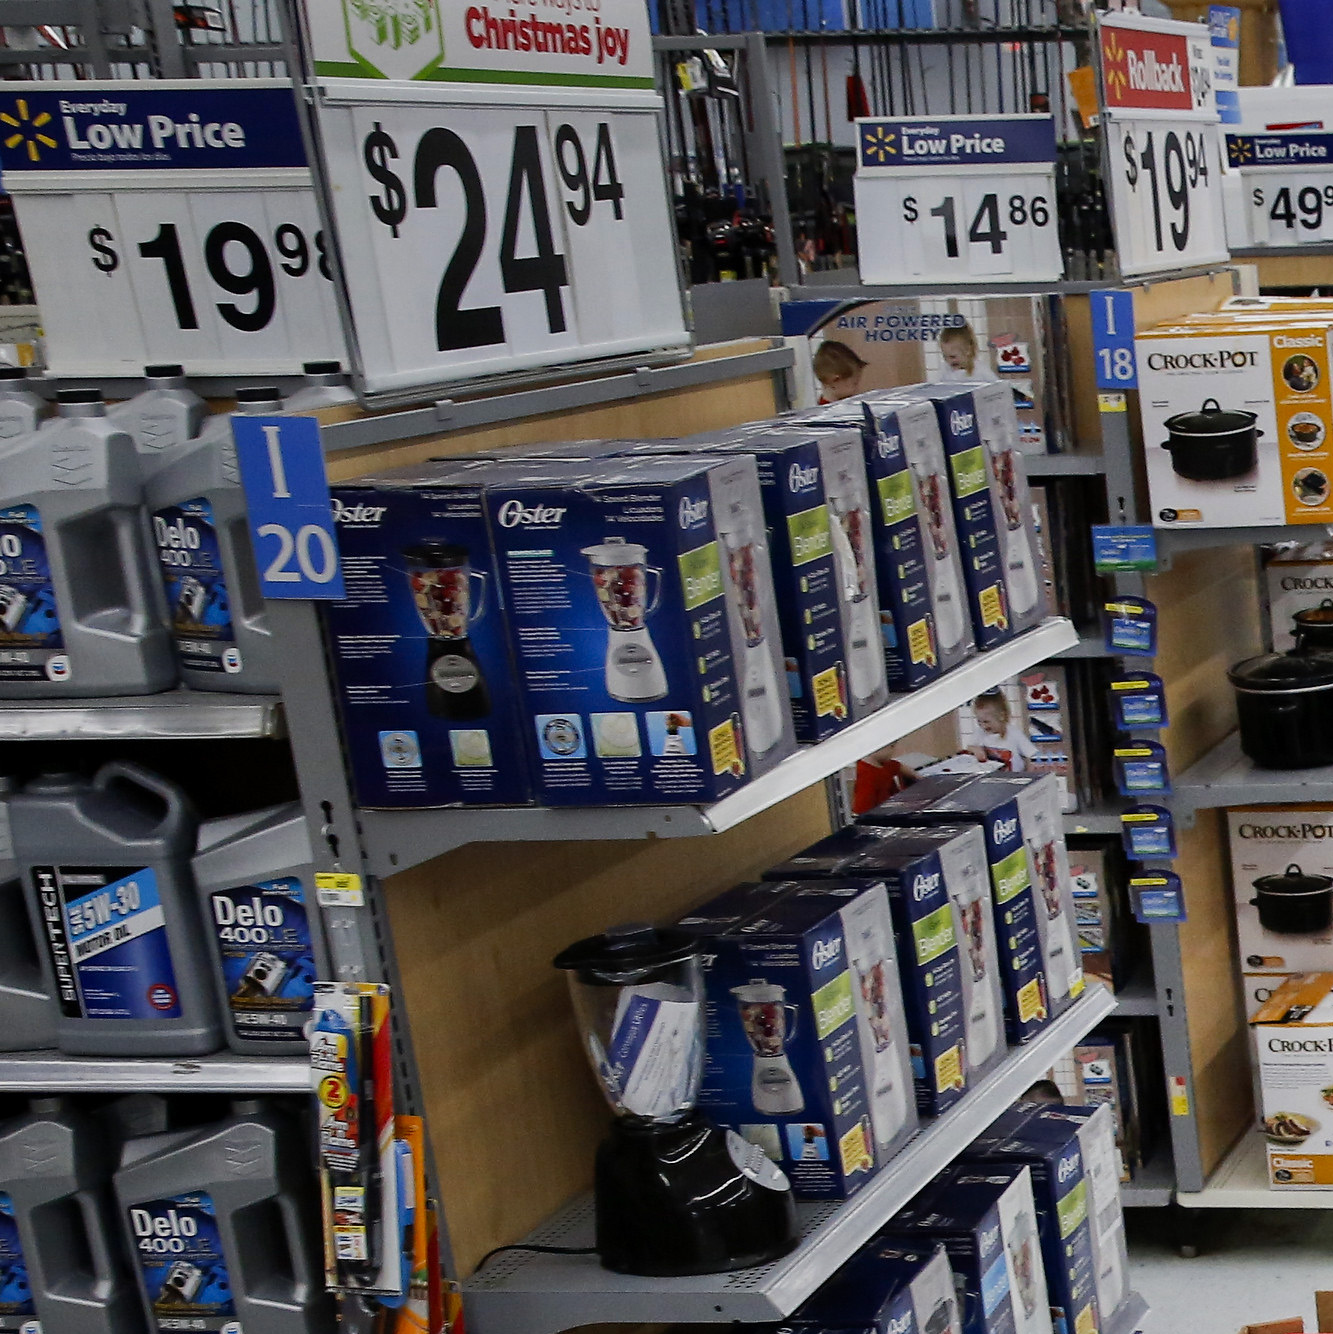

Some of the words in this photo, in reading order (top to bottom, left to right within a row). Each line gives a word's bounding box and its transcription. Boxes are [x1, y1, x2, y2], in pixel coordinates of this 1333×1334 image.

[465, 8, 592, 57] Christmas
[594, 20, 631, 65] joy
[1127, 50, 1185, 94] Rollback
[59, 99, 127, 116] Everyday
[62, 115, 144, 150] Low
[150, 112, 246, 150] Price
[902, 135, 949, 156] Low
[951, 133, 1005, 155] Price
[1255, 144, 1286, 159] Low
[1289, 143, 1328, 159] Price
[836, 315, 869, 328] AIR
[875, 313, 966, 328] POWERED
[865, 328, 940, 343] HOCKEY
[1273, 333, 1325, 349] Classic
[1098, 348, 1135, 381] 18
[950, 409, 974, 437] Oster
[788, 462, 819, 494] Oster
[498, 499, 567, 528] Oster
[678, 496, 709, 531] Oster
[153, 516, 201, 550] Delo
[256, 523, 338, 584] 20
[993, 818, 1018, 846] Oster
[912, 872, 940, 902] Oster
[83, 880, 141, 925] 5W-30
[211, 895, 285, 928] Delo
[218, 926, 270, 945] 400
[812, 936, 841, 970] Oster
[327, 1079, 342, 1099] 2
[131, 1208, 199, 1238] Delo
[138, 1237, 186, 1254] 400
